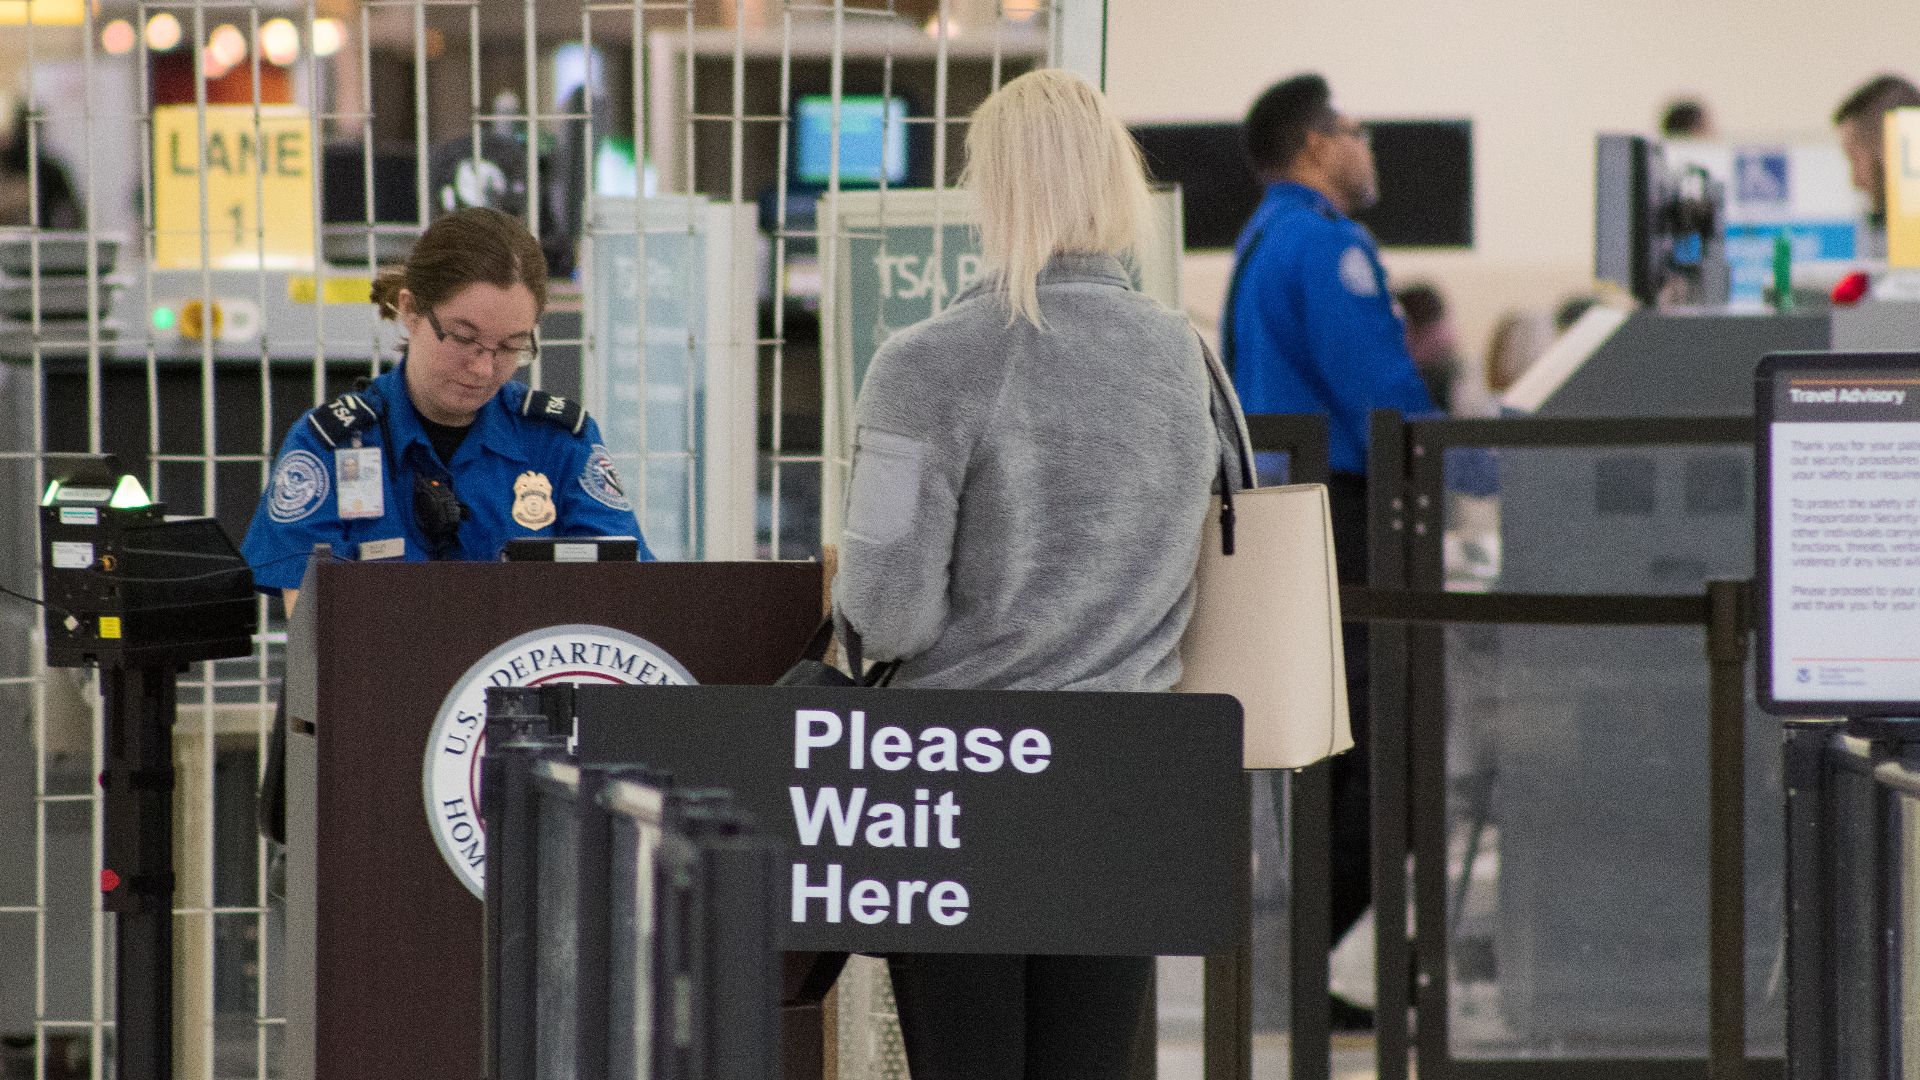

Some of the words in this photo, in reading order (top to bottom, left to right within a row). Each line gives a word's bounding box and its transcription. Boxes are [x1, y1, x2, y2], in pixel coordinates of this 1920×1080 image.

[169, 131, 304, 176] LANE
[228, 203, 243, 244] 1
[873, 254, 949, 299] TSA
[545, 395, 566, 414] TSA
[1790, 387, 1836, 403] Travel
[1839, 388, 1906, 405] Advisory
[328, 398, 356, 427] TSA
[1791, 440, 1824, 451] Thank
[1826, 441, 1848, 453] you
[1850, 440, 1865, 451] for
[1869, 442, 1894, 453] your
[1791, 471, 1815, 481] your
[1819, 469, 1852, 482] safety
[1856, 470, 1877, 480] and
[1812, 455, 1854, 468] security
[1791, 512, 1872, 524] Transportation
[1807, 498, 1845, 510] protect
[1848, 498, 1866, 508] the
[1869, 498, 1902, 510] safety
[1791, 585, 1826, 596] Please
[1891, 587, 1915, 598] your
[444, 709, 483, 756] U.S.
[490, 641, 677, 687] DEPARTME
[794, 709, 1051, 774] Please
[789, 786, 961, 849] Wait
[443, 797, 486, 872] HOM
[791, 863, 970, 926] Here
